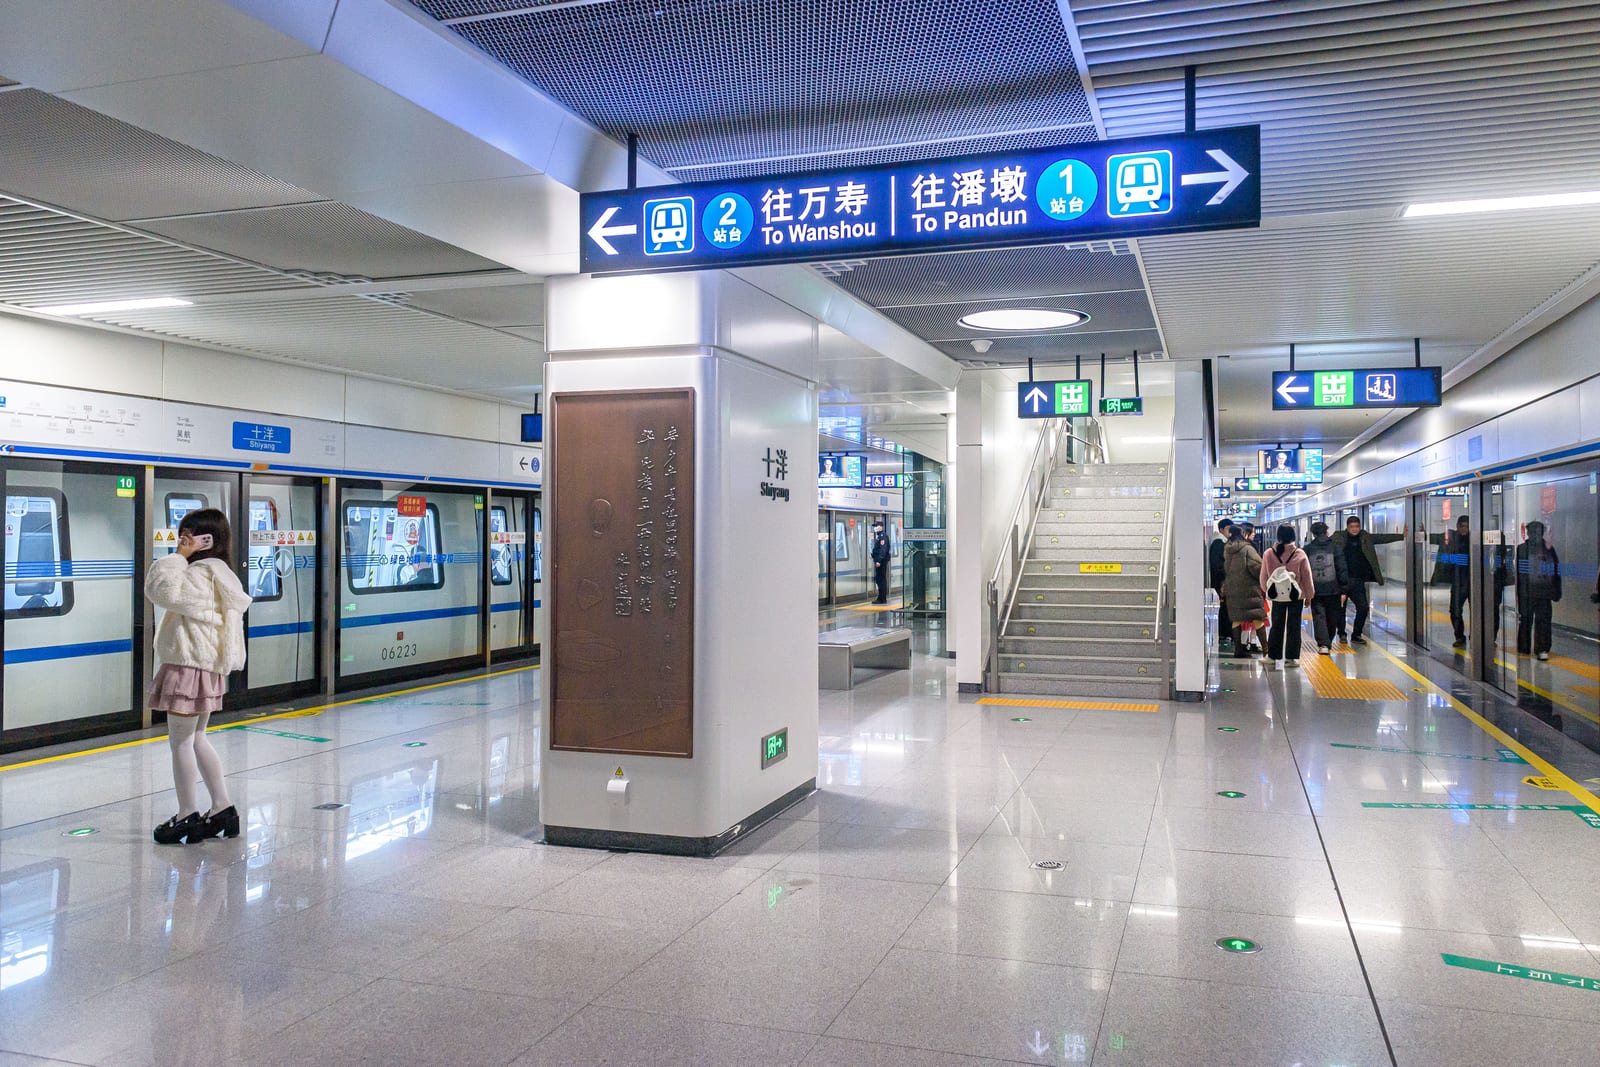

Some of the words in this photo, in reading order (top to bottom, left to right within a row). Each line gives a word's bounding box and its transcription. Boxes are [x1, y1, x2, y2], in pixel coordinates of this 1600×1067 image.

[911, 165, 1027, 211] 往潘墩
[1059, 163, 1073, 195] 1
[719, 197, 737, 226] 2
[761, 181, 869, 225] 往万寿
[1049, 196, 1084, 215] 站台
[912, 213, 938, 233] To
[944, 208, 1027, 231] Pandun
[713, 226, 742, 243] 站台
[761, 226, 784, 246] To
[788, 220, 876, 243] Wanshou
[1062, 403, 1083, 413] EXIT
[1322, 394, 1347, 404] EXIT
[250, 425, 274, 441] 十洋
[249, 440, 276, 450] Shiyang
[761, 447, 788, 481] 十洋
[120, 478, 132, 488] 10
[760, 481, 790, 502] Shiyang
[381, 643, 417, 661] 06223
